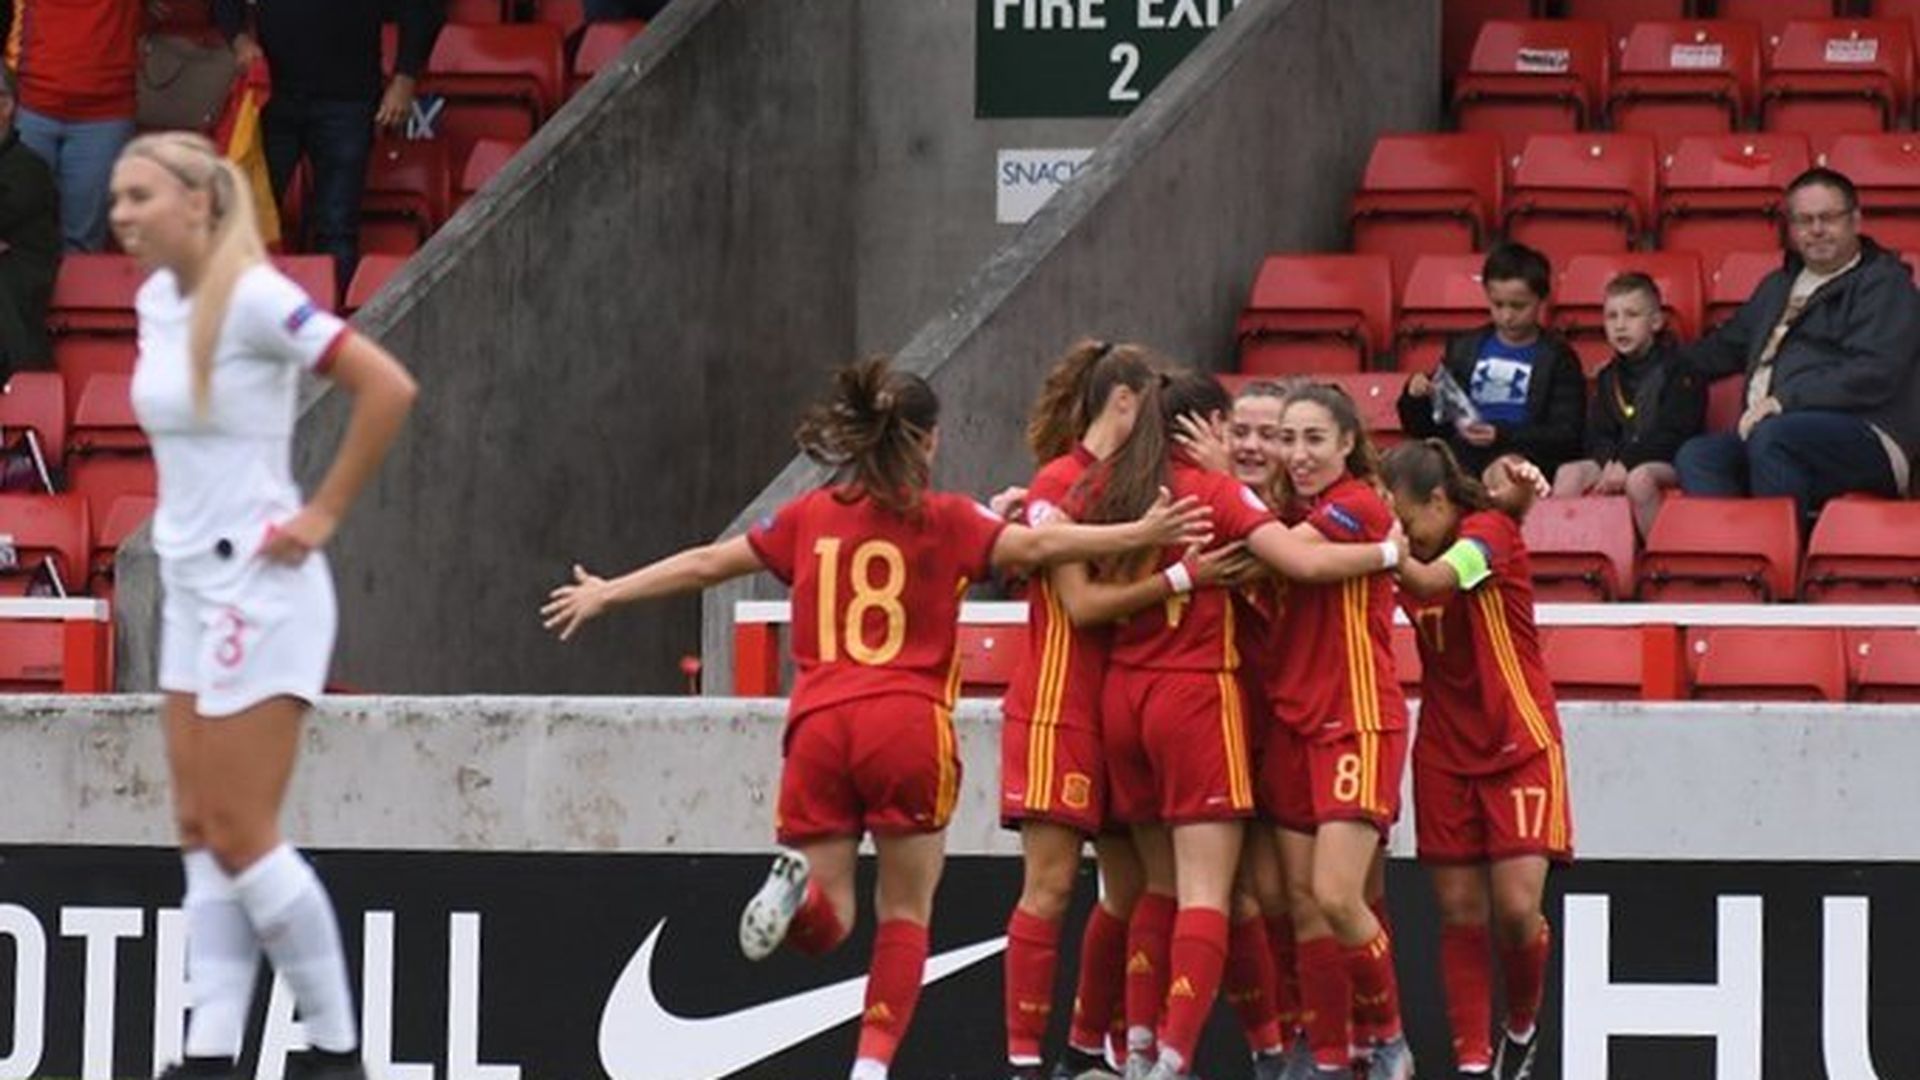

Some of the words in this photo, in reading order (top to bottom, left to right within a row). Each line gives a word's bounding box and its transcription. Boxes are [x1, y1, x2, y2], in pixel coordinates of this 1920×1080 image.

[1108, 43, 1140, 101] 2
[814, 537, 907, 666] 18
[1333, 754, 1361, 802] 8
[1511, 786, 1547, 839] 17
